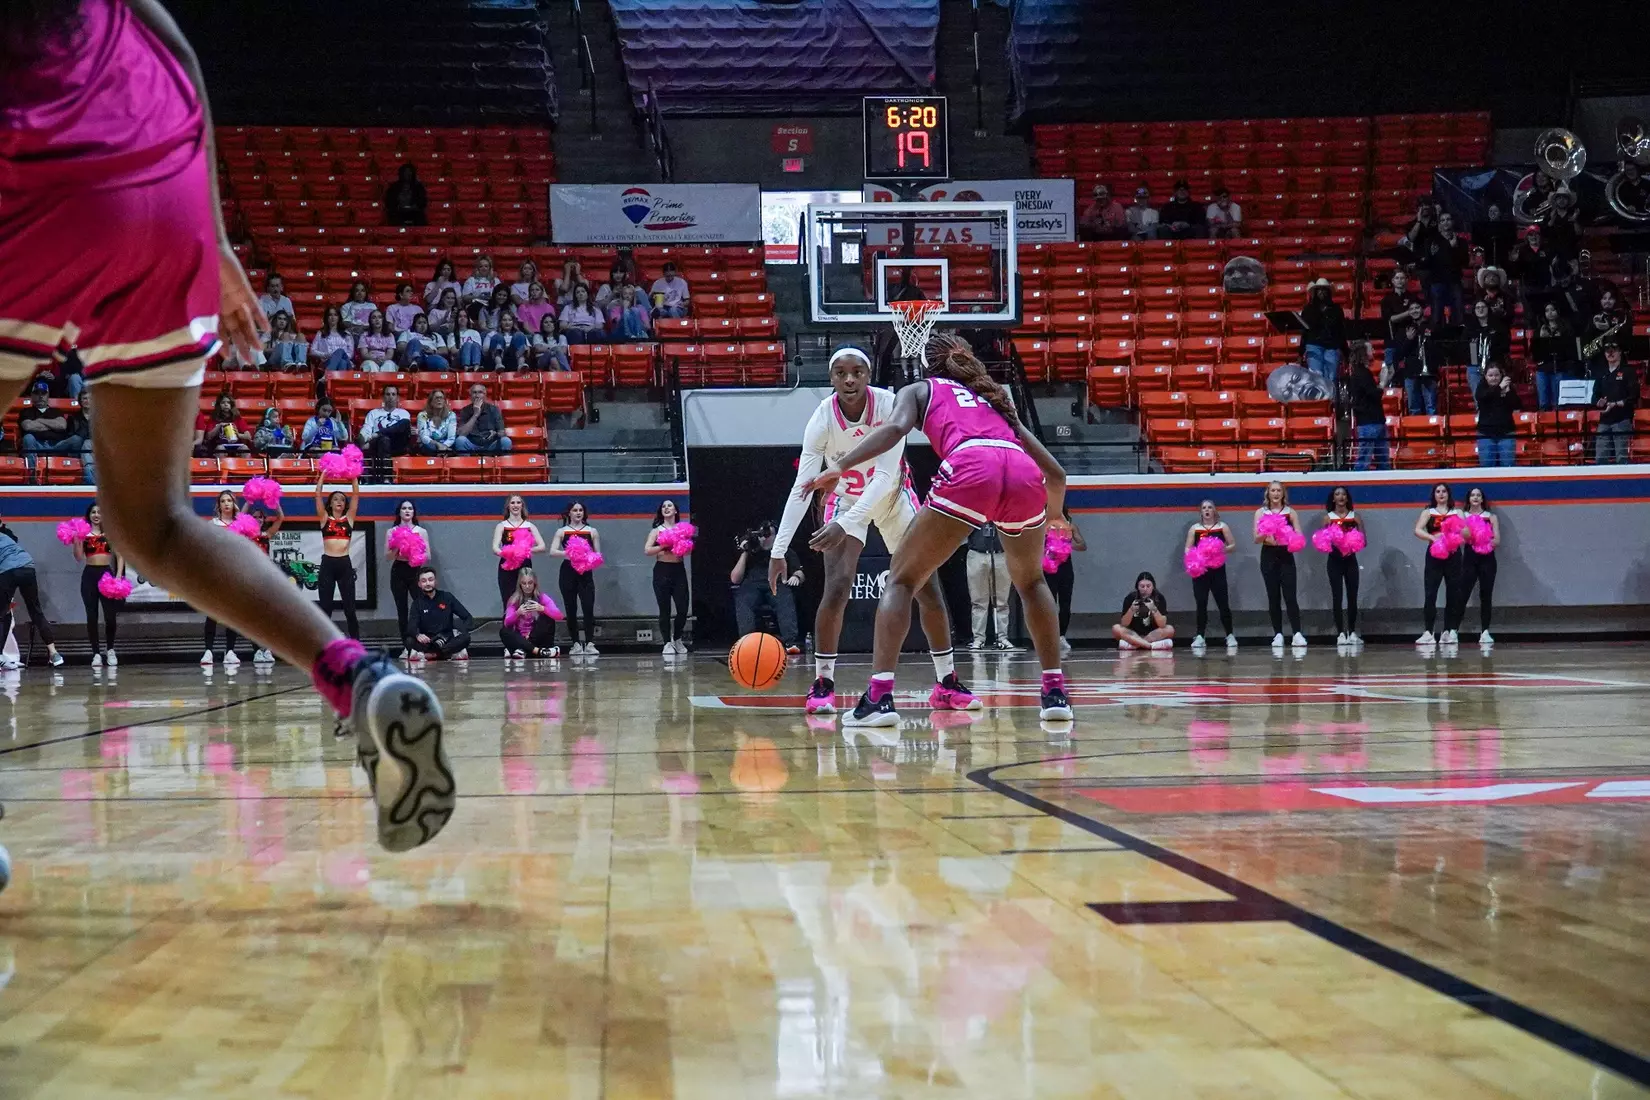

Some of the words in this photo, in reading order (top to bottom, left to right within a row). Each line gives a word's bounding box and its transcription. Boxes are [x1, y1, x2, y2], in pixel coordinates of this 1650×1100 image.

[887, 106, 937, 128] 6:20
[777, 127, 808, 135] Section
[788, 139, 799, 151] S
[898, 131, 930, 168] 19
[623, 196, 649, 204] RE/MAX
[1015, 190, 1041, 201] EVERY
[652, 196, 684, 209] Prime
[1015, 200, 1054, 210] DNESDAY
[649, 210, 696, 224] Properties
[888, 227, 973, 244] PZZAS
[282, 532, 301, 540] RANCH
